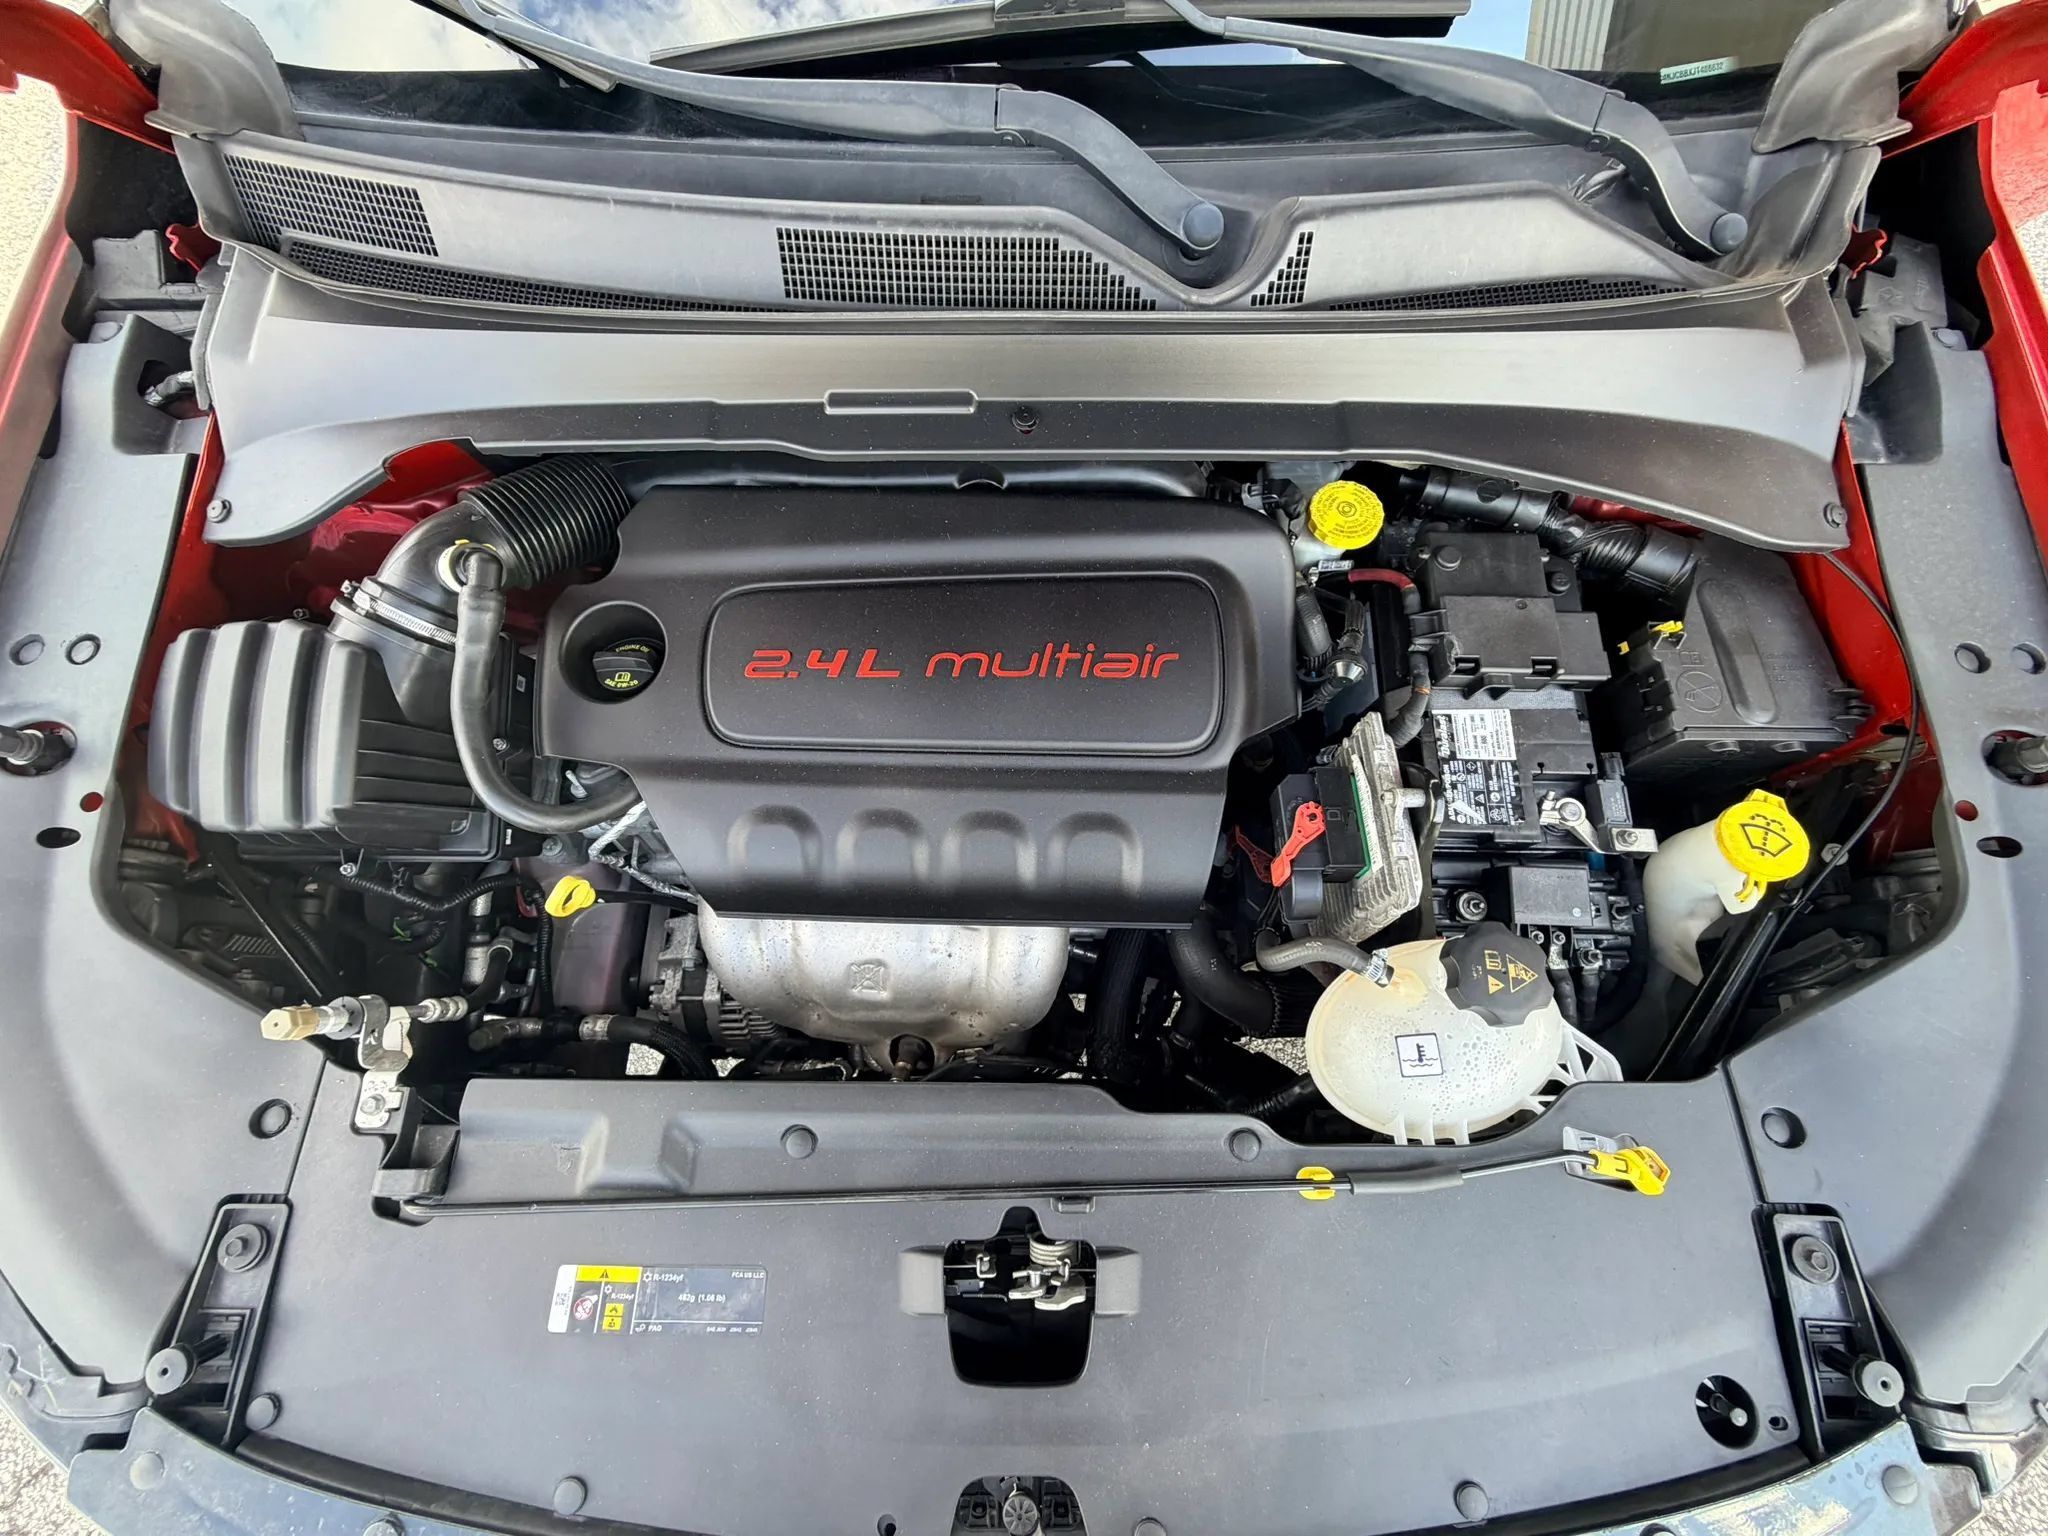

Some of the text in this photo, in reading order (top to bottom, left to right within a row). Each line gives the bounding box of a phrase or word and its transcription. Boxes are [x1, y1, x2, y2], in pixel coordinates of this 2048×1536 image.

[615, 644, 639, 653] ENGINE
[925, 643, 1180, 678] multiair
[1437, 714, 1450, 758] Duralast
[653, 1274, 683, 1286] R-1234yf
[731, 1271, 744, 1279] FCA
